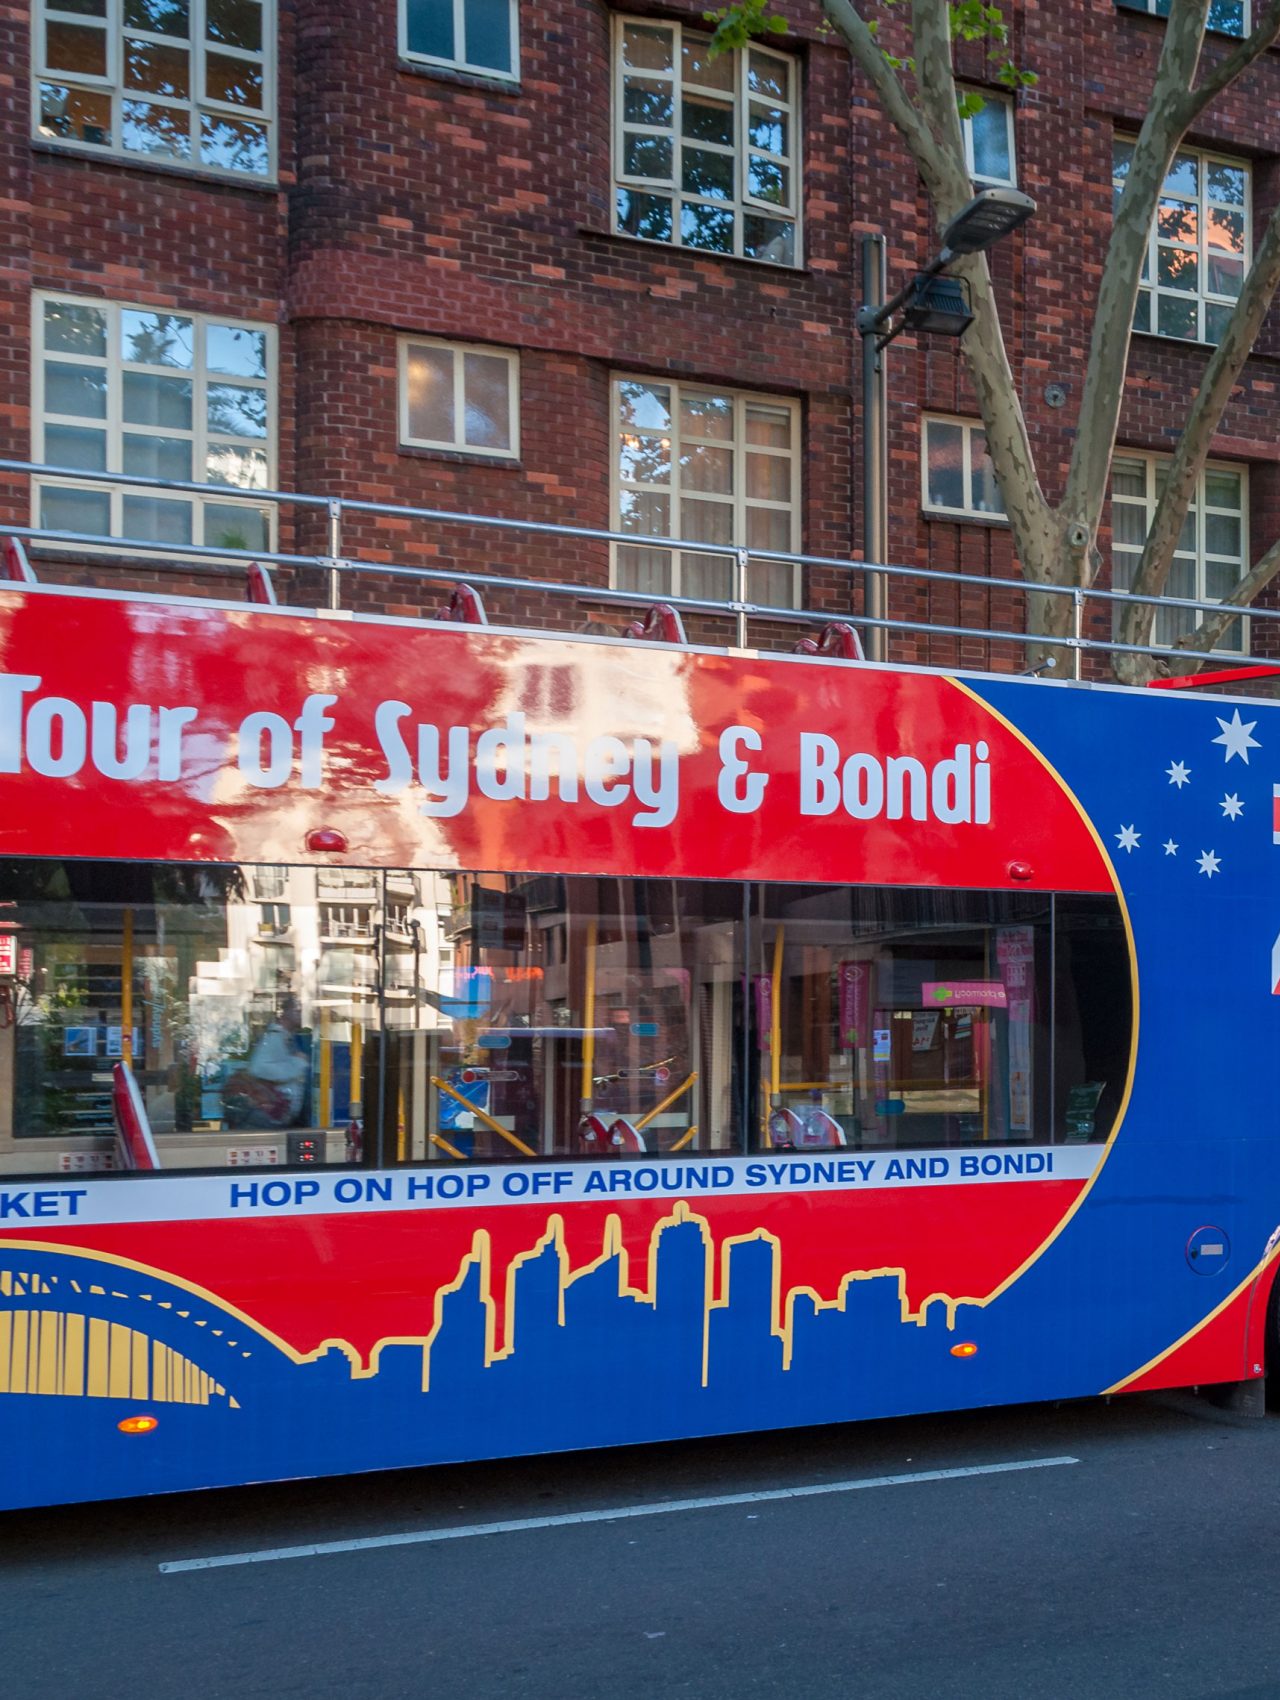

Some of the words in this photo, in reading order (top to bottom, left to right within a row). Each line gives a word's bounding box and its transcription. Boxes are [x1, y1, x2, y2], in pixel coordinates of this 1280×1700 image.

[0, 673, 197, 780] Tour
[238, 694, 338, 789] of
[373, 700, 679, 827] Sydney
[718, 725, 769, 814] &
[800, 731, 991, 825] Bondi
[0, 1190, 88, 1218] KET
[230, 1181, 320, 1207] HOP
[333, 1178, 392, 1203] ON
[407, 1174, 490, 1200] HOP
[502, 1171, 574, 1196] OFF
[583, 1165, 735, 1193] AROUND
[745, 1160, 876, 1186] SYDNEY
[885, 1157, 950, 1180] AND
[959, 1152, 1053, 1176] BONDI
